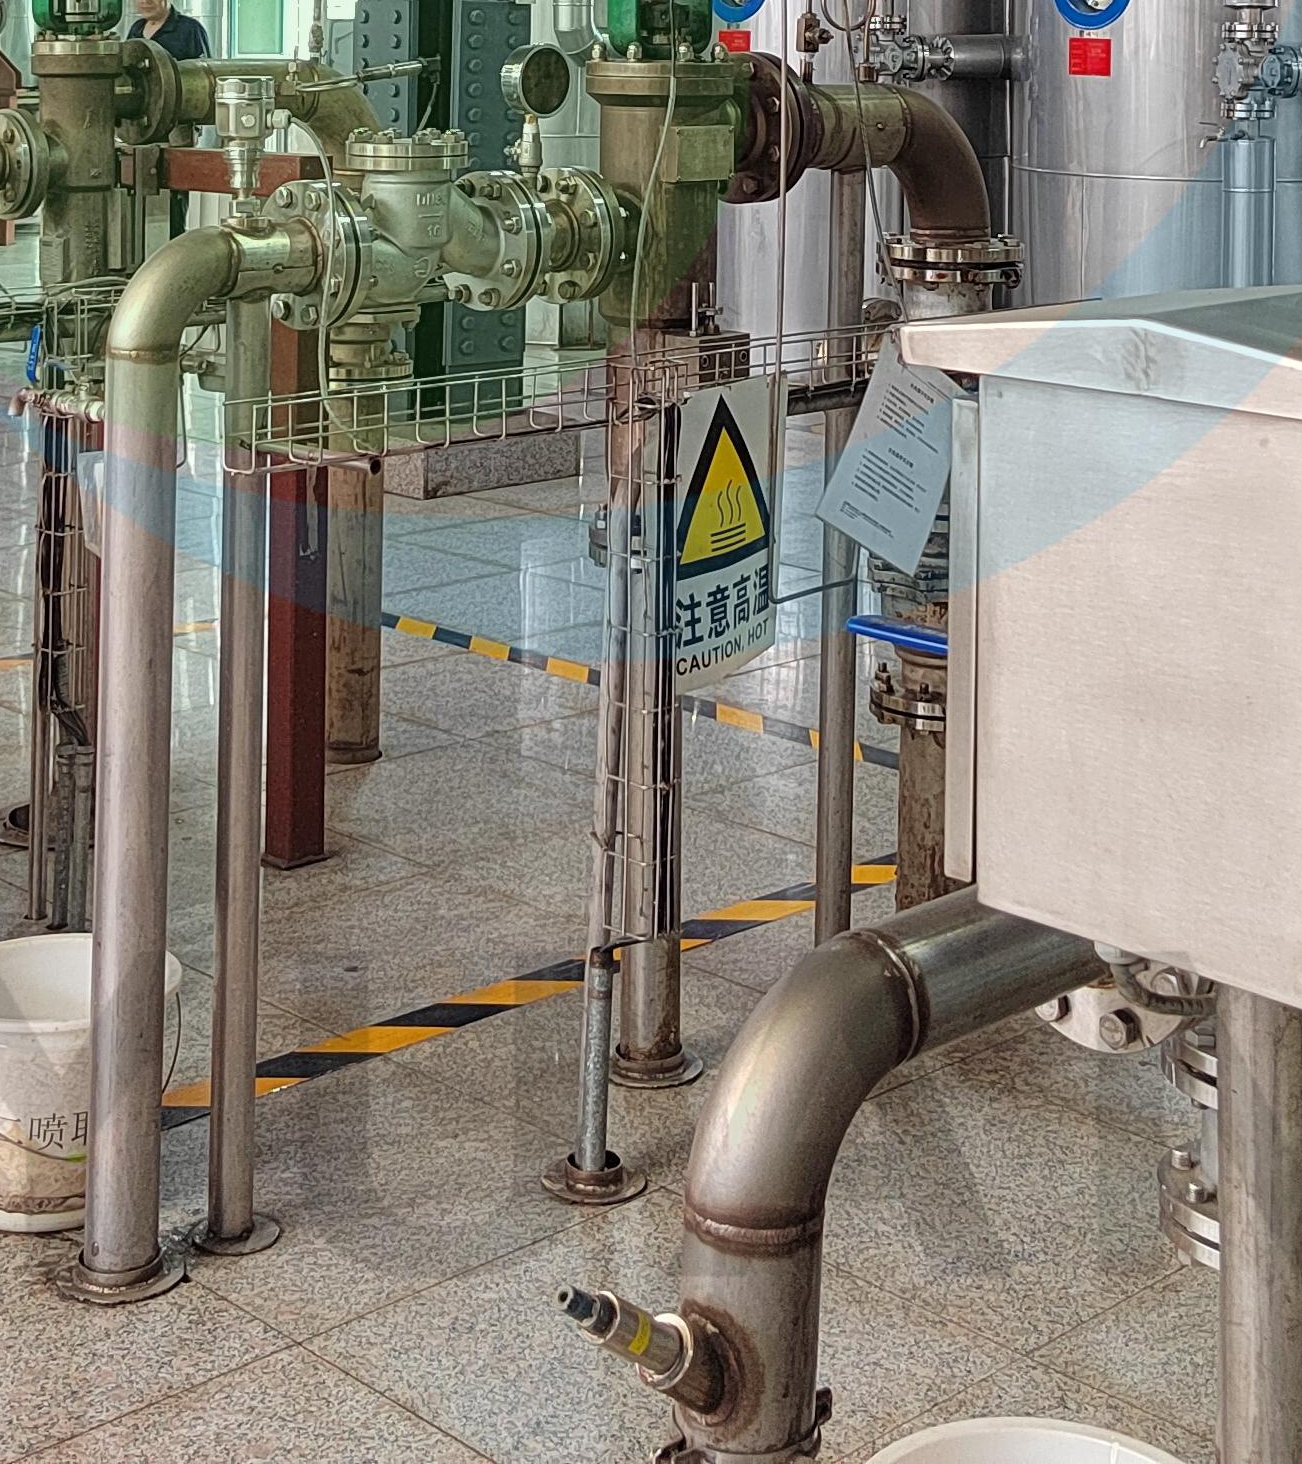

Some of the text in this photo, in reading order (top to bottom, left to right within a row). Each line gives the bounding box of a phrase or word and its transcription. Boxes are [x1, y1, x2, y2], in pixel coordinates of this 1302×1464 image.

[675, 563, 769, 650] 注意高温
[676, 617, 769, 676] CAUTION, HOT
